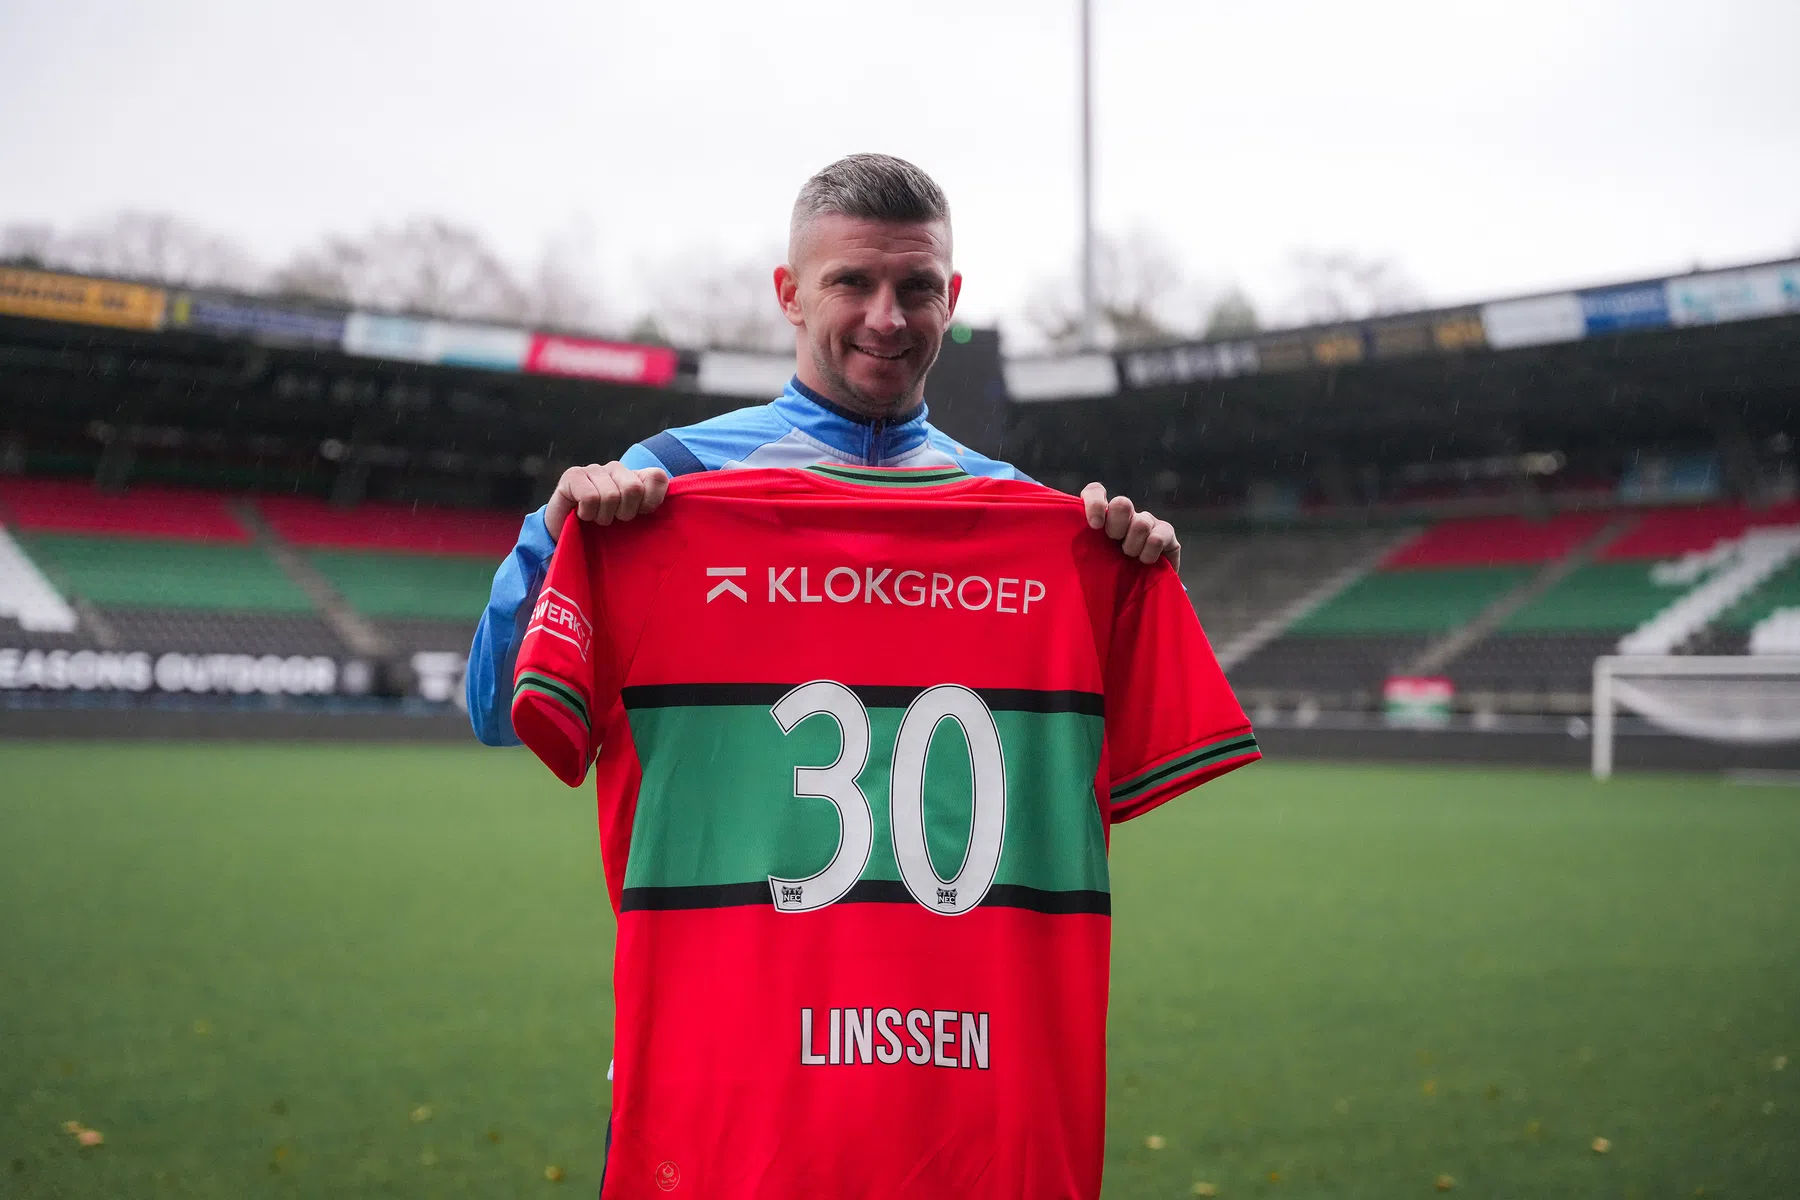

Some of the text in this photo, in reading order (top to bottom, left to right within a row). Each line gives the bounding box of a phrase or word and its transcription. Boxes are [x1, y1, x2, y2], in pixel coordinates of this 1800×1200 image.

[768, 566, 1046, 614] KLOKGROEP
[154, 651, 336, 695] OUTDOOR
[767, 679, 1008, 917] 30
[784, 894, 801, 902] NEC
[938, 896, 955, 904] NEC
[800, 1007, 990, 1070] LINSSEN
